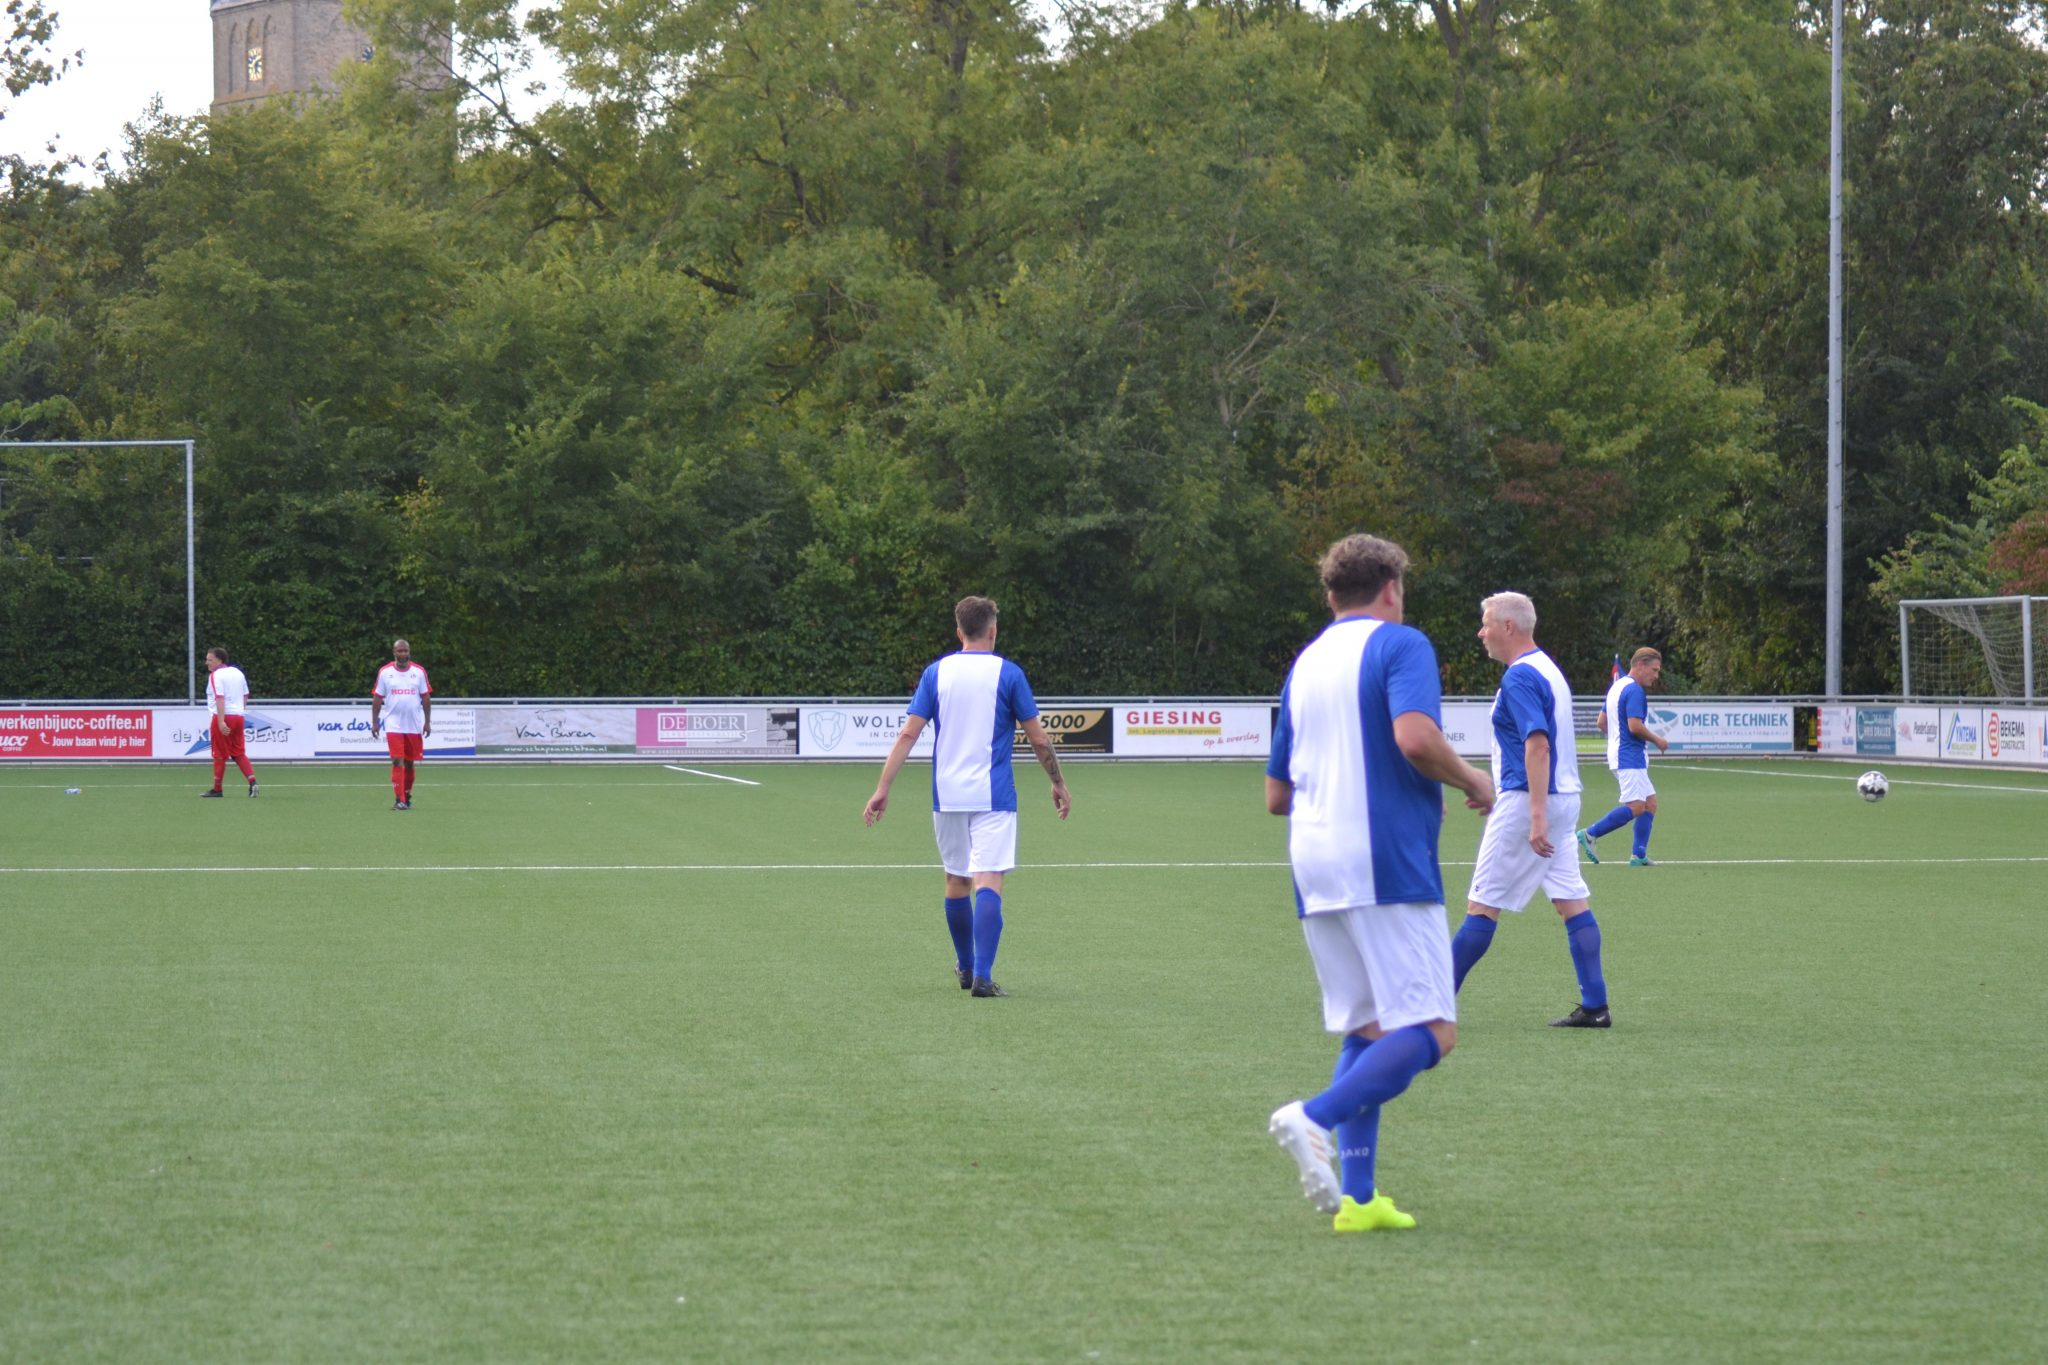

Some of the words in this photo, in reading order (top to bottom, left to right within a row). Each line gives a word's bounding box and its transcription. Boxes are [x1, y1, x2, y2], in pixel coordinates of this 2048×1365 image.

[0, 714, 147, 732] werkenbijucc-coffee.nl
[662, 716, 686, 730] DE
[693, 716, 740, 730] BOER
[1127, 711, 1222, 724] GIESING
[1683, 713, 1719, 726] OMER
[1725, 713, 1788, 726] TECHNIEK
[318, 722, 342, 731] van
[347, 718, 372, 731] der
[2001, 721, 2025, 736] BEKEMA
[173, 730, 191, 742] de
[516, 725, 544, 738] Van
[551, 728, 596, 738] Buren
[1956, 726, 1977, 742] YNTEMA
[53, 736, 73, 746] Jouw
[76, 736, 96, 746] baan
[99, 736, 117, 746] vind
[118, 736, 127, 748] je
[129, 736, 146, 746] hier
[1204, 738, 1215, 748] Op
[1226, 732, 1260, 743] overslag
[1341, 1147, 1369, 1160] JAKO
